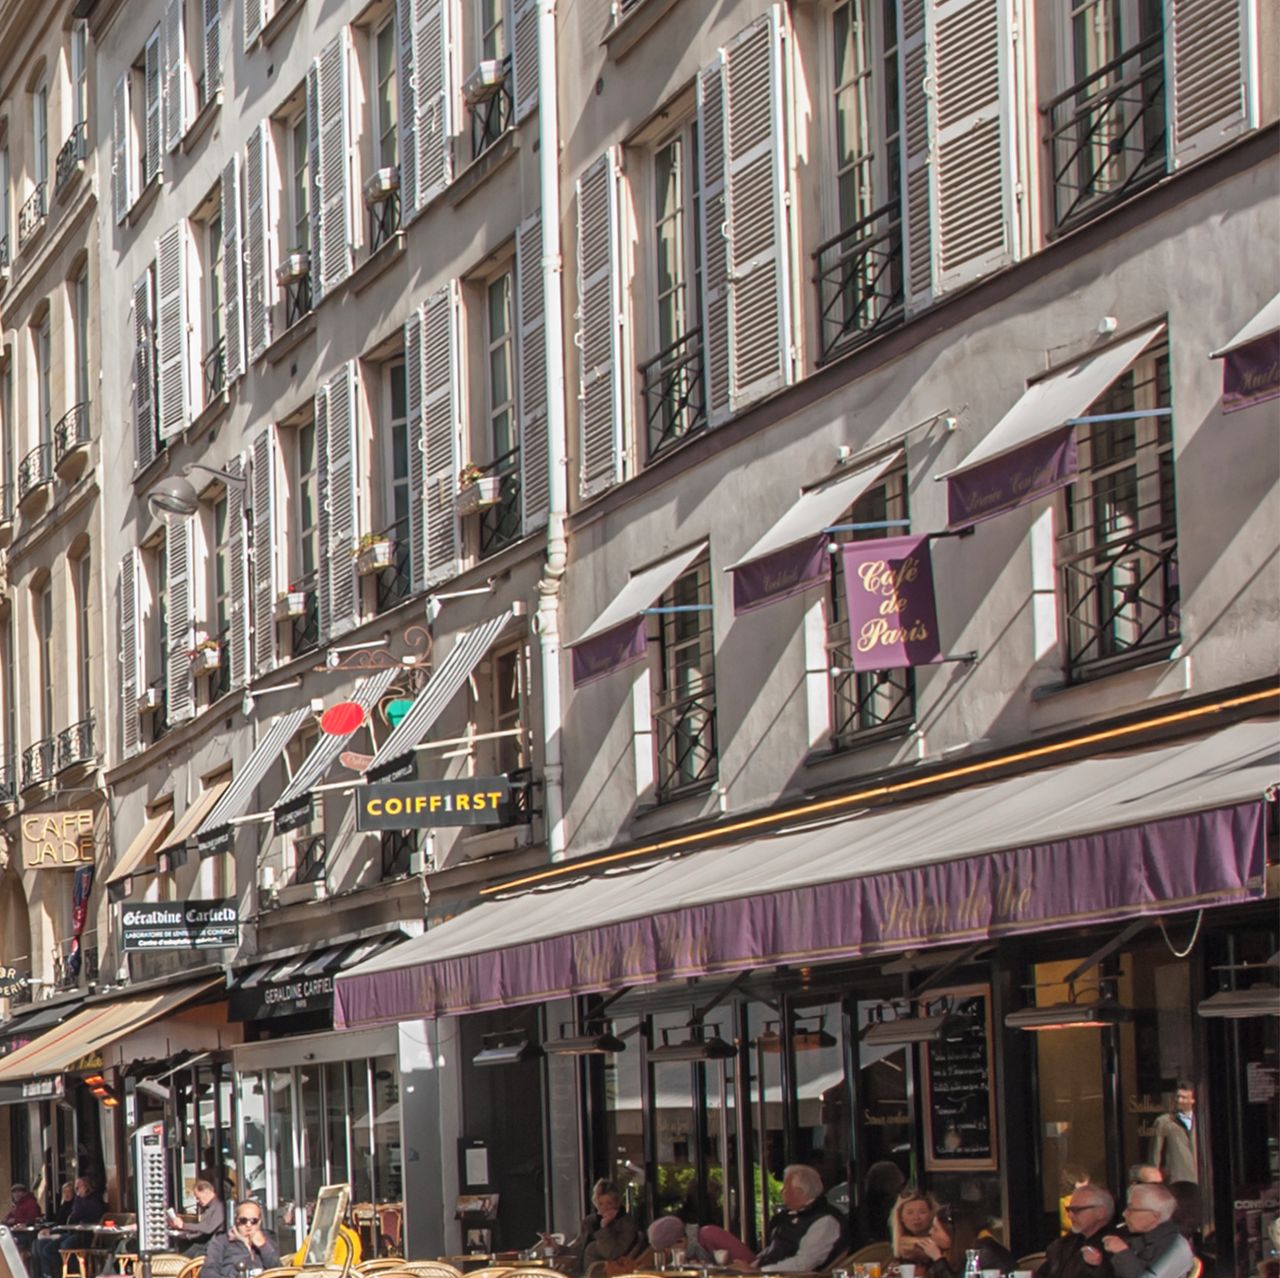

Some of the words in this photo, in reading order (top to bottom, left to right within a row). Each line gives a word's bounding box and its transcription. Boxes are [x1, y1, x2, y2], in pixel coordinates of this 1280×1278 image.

[858, 557, 919, 596] Café
[879, 588, 908, 615] de
[857, 618, 928, 652] Paris
[23, 812, 93, 842] CAFE
[28, 839, 93, 866] JADE
[123, 909, 182, 926] Géraldine
